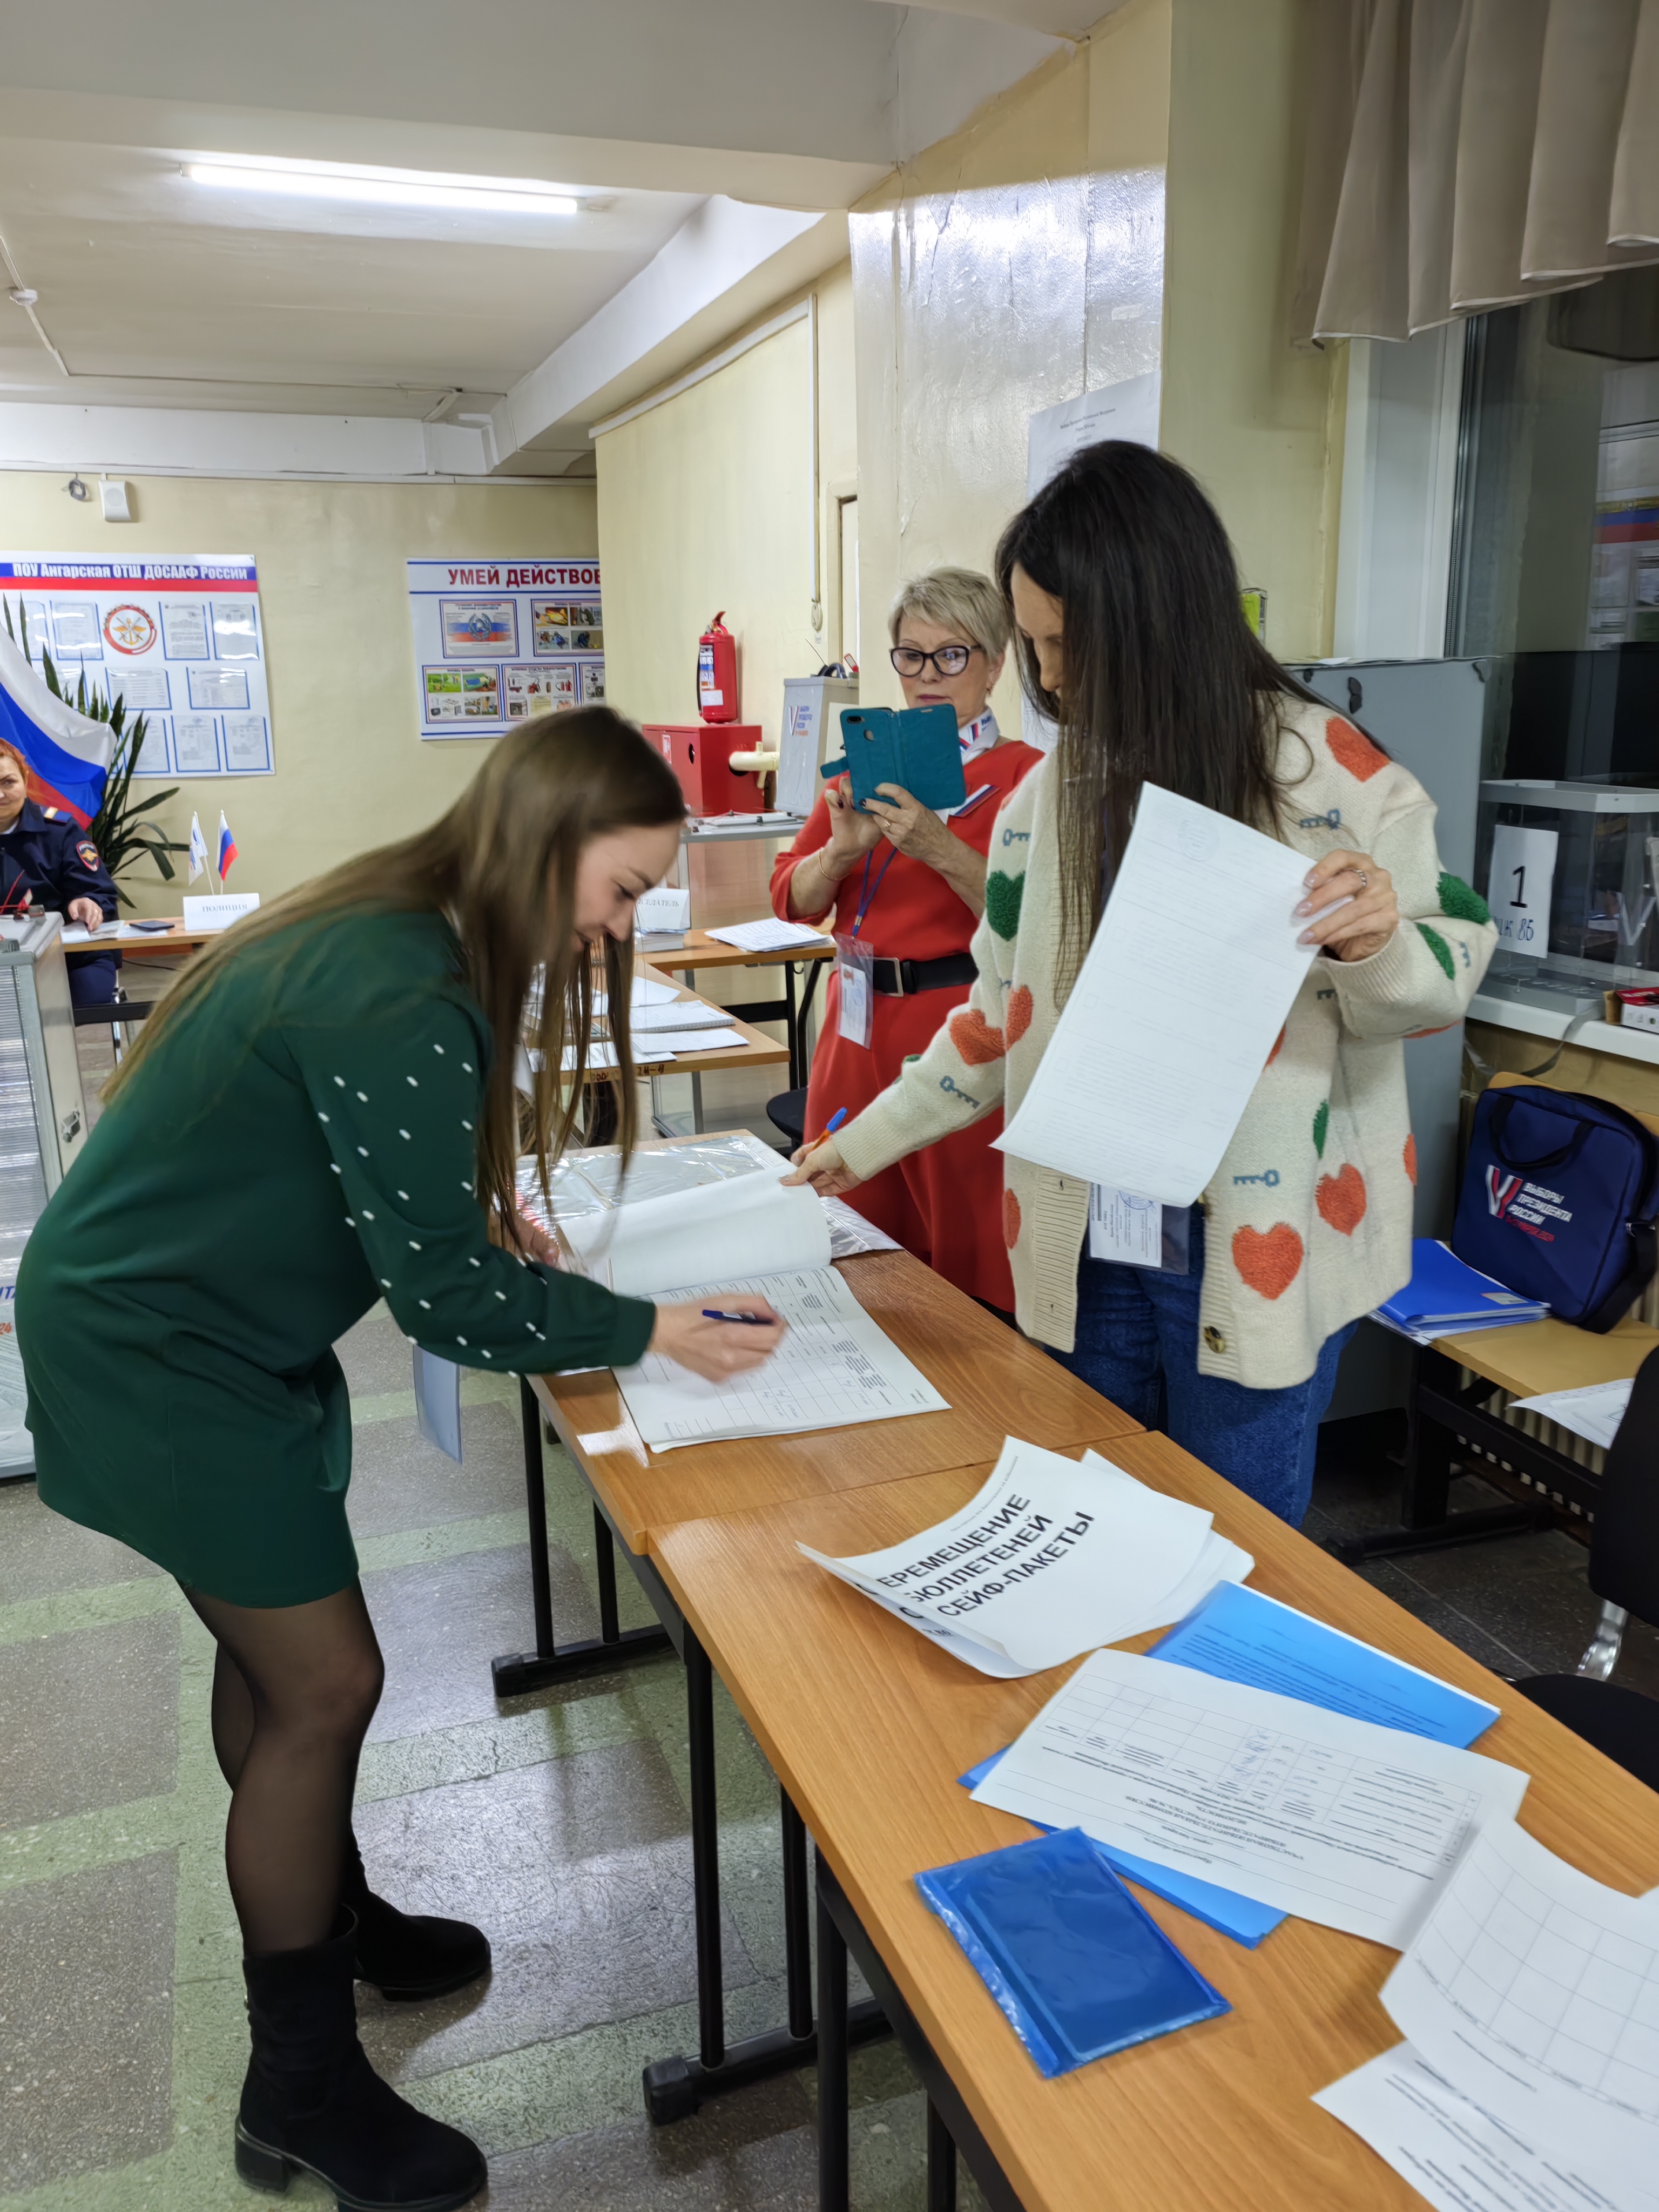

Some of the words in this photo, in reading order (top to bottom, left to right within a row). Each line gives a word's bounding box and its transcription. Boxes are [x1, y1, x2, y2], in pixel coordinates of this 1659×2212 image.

[12, 563, 38, 577] ПОУ
[41, 563, 111, 579] Ангарская
[112, 564, 141, 578] ОТШ
[144, 565, 198, 581] ДОСААФ
[200, 567, 248, 580] России
[448, 565, 500, 585] УМЕЙ
[1510, 866, 1528, 908] 1
[1506, 1204, 1546, 1225] РОССИИ
[876, 1494, 1031, 1588] ЕРЕМЕЩЕНИЕ
[937, 1511, 1095, 1616] СЕЙФ-ПАКЕТЫ
